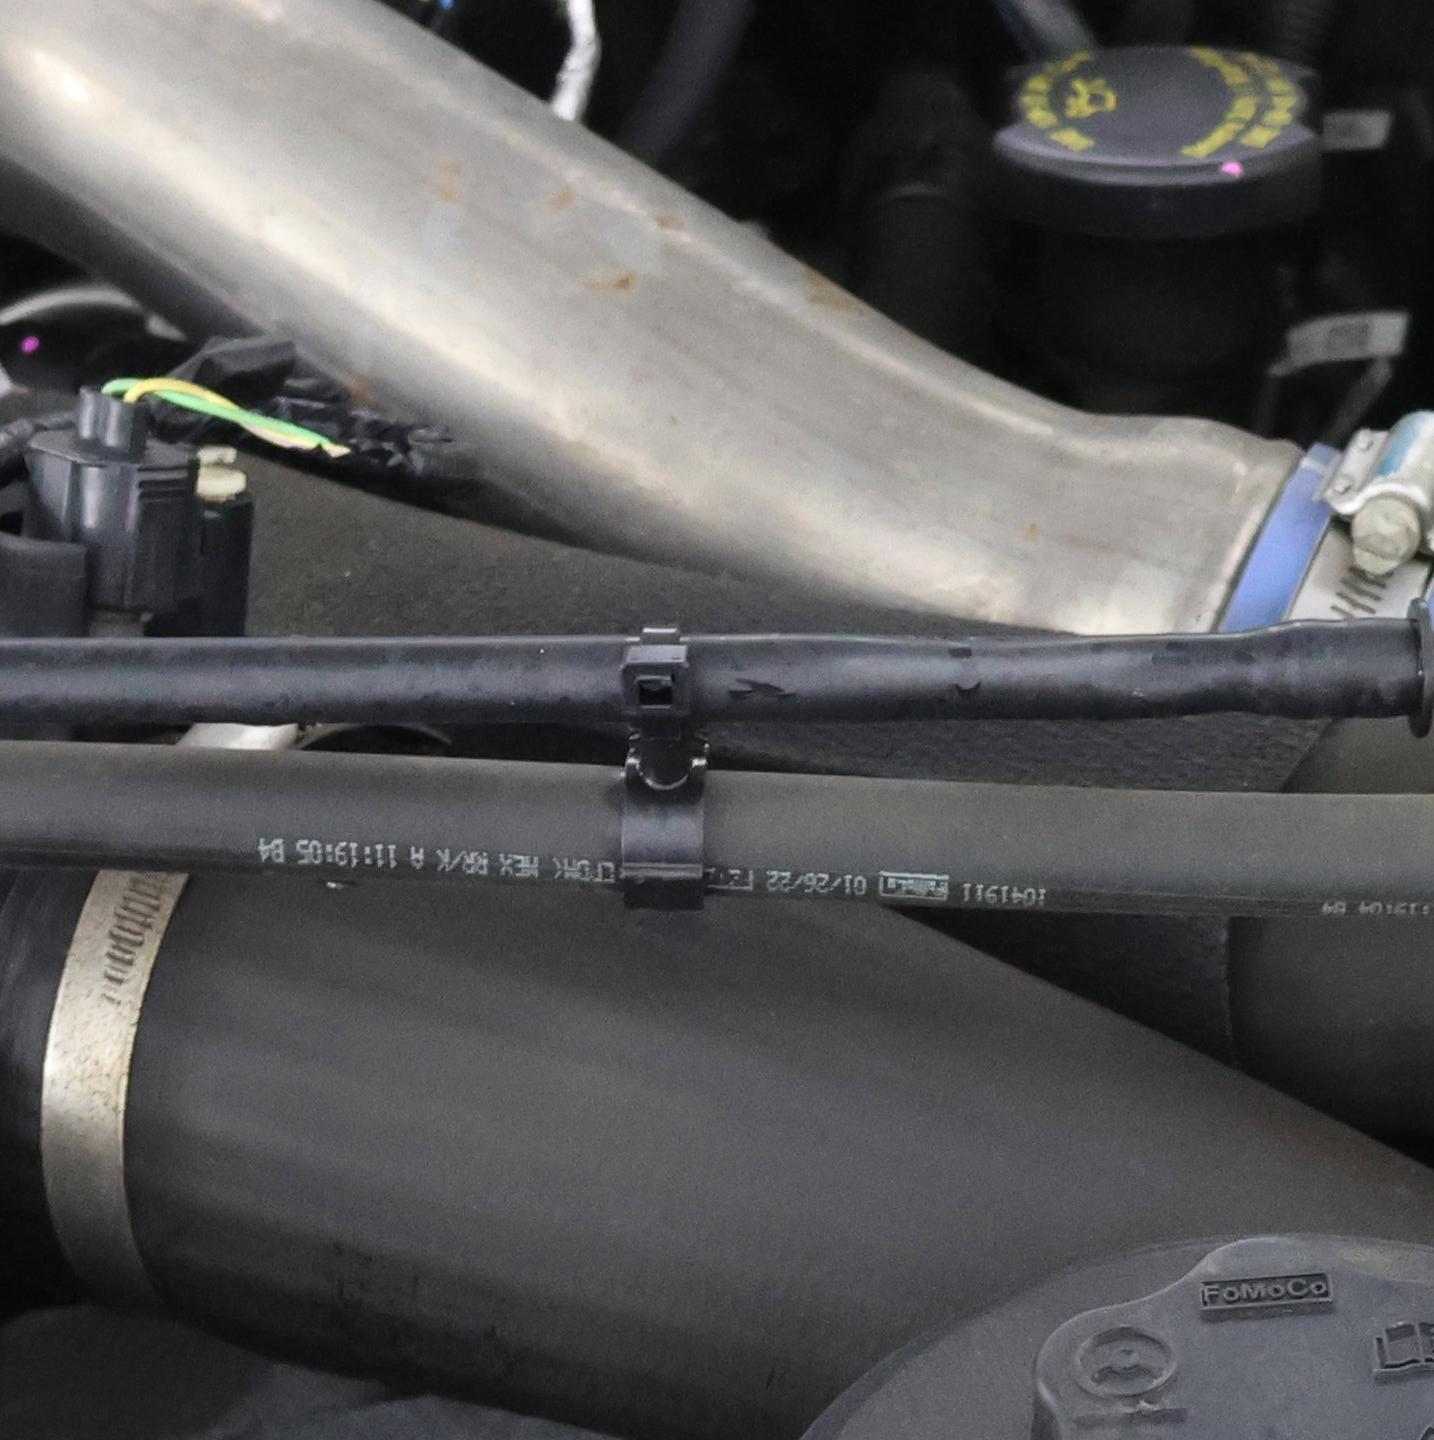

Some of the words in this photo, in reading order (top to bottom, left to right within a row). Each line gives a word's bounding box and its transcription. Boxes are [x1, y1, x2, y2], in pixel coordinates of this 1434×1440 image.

[258, 837, 284, 864] B4
[296, 840, 398, 870] 11:19:05
[410, 846, 425, 870] A
[766, 869, 866, 896] 01/26/22
[962, 881, 1047, 906] 1041911
[1203, 1276, 1329, 1305] FoMoCo
